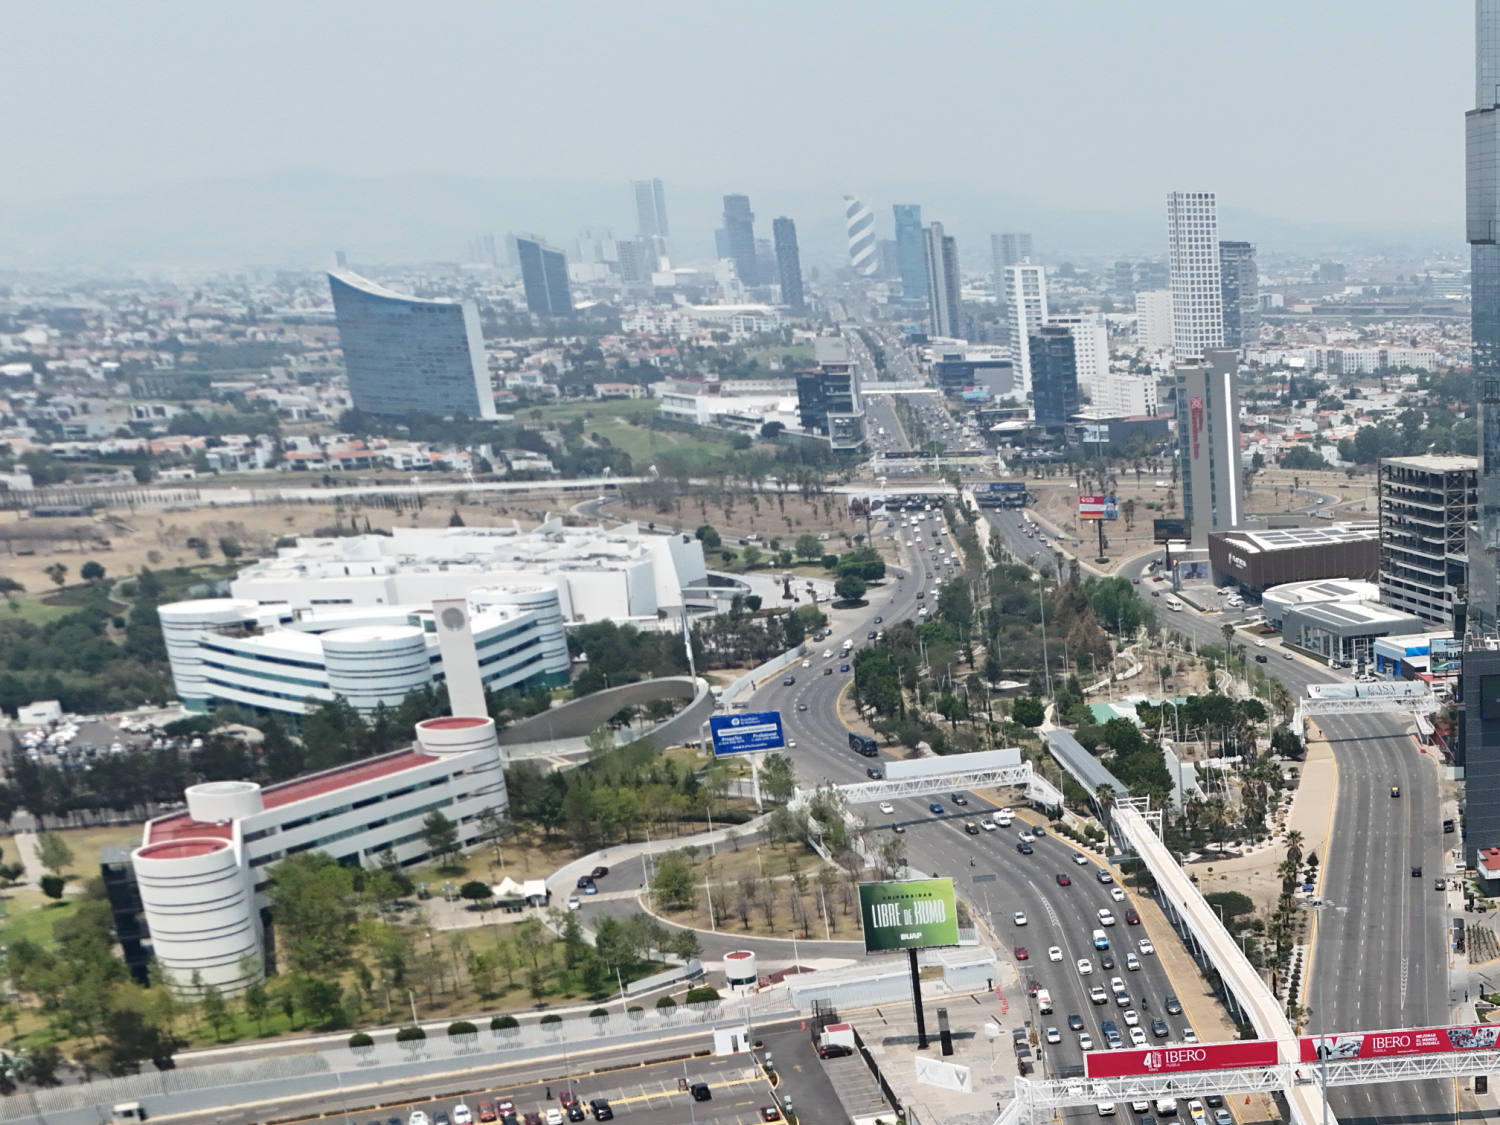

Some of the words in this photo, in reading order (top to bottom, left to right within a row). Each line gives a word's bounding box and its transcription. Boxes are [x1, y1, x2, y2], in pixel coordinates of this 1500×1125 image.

[872, 902, 902, 928] LIBRE
[903, 909, 913, 926] DE
[914, 899, 946, 925] HUMO
[900, 932, 922, 940] BUAP
[1372, 1035, 1411, 1049] IBERO
[1143, 1051, 1162, 1068] 40
[1165, 1048, 1207, 1064] IBERO
